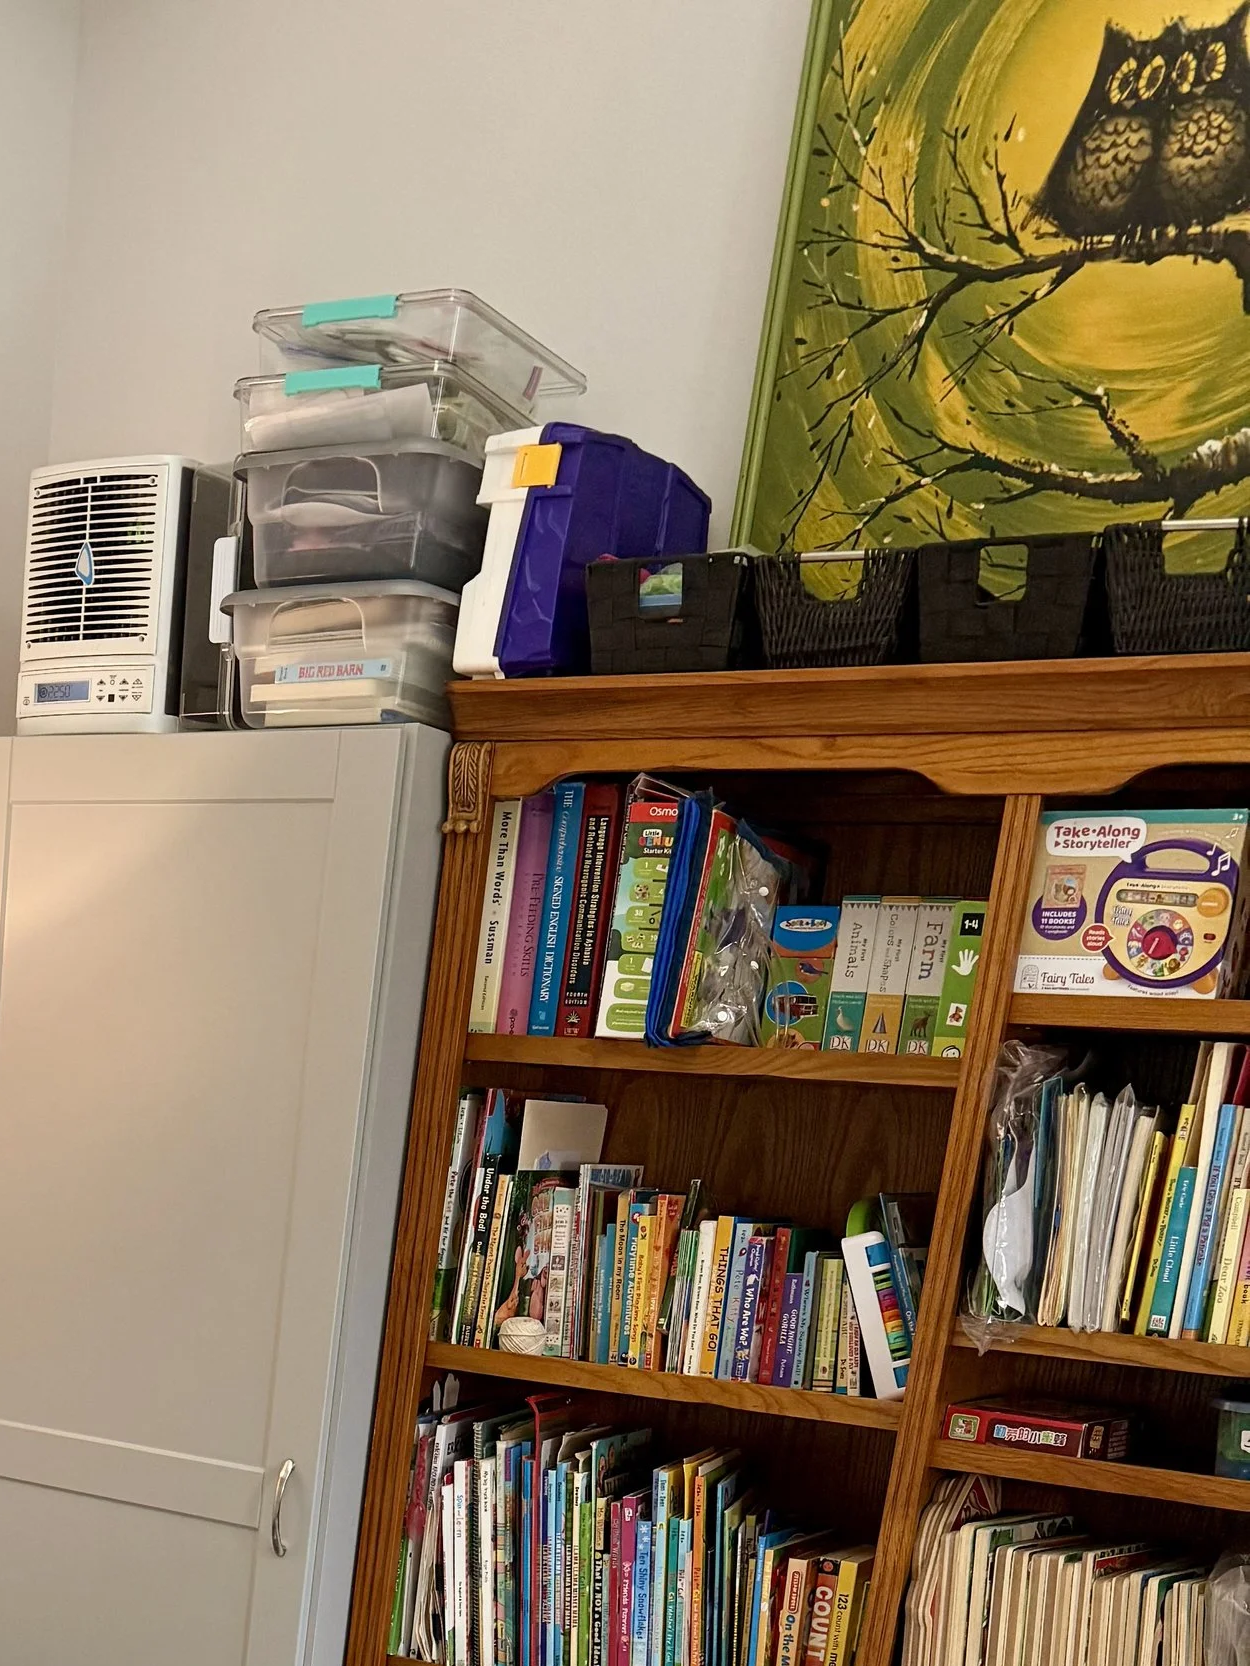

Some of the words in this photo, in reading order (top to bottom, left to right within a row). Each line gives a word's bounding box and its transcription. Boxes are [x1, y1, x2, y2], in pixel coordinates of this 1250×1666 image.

[298, 666, 315, 679] BIG
[316, 665, 335, 678] RED
[336, 663, 364, 677] BARN
[563, 790, 574, 808] THE
[650, 806, 679, 817] Osmo
[501, 811, 513, 839] More
[587, 817, 596, 831] and
[596, 817, 609, 851] Language
[584, 832, 595, 858] Related
[1061, 839, 1133, 850] Storyteller
[497, 844, 509, 868] Than
[579, 859, 592, 898] Neurogenic
[592, 852, 605, 893] Intervention
[551, 876, 564, 909] SIGNED
[586, 894, 600, 930] Strategies
[1041, 917, 1049, 925] 11
[546, 911, 560, 948] ENGLISH
[573, 899, 587, 951] Communication
[886, 913, 899, 947] Colors
[963, 919, 979, 930] 1-4
[484, 920, 499, 965] Sussman
[583, 938, 594, 966] Aphasia
[844, 922, 863, 979] Animals
[918, 921, 944, 980] Farm
[520, 945, 535, 977] SKILLS
[568, 952, 581, 985] Disorders
[539, 951, 555, 1002] DICTIONARY
[879, 957, 893, 993] Shapes
[1040, 972, 1067, 987] Fairy
[1068, 972, 1095, 984] Tales
[831, 1036, 850, 1049] DK
[868, 1039, 887, 1052] DK
[908, 1039, 927, 1053] DK
[483, 1167, 495, 1194] Under
[481, 1196, 490, 1210] the
[1230, 1196, 1241, 1231] Campbell
[477, 1211, 488, 1232] Bed!
[475, 1241, 483, 1255] David
[618, 1234, 626, 1253] Moon
[1167, 1236, 1180, 1258] Little
[1197, 1234, 1209, 1267] Pancake
[615, 1265, 623, 1277] my
[637, 1255, 645, 1275] Baby's
[714, 1247, 730, 1294] THINGS
[1162, 1259, 1176, 1283] Cloud
[1222, 1257, 1233, 1282] Dear
[614, 1279, 622, 1300] Room
[733, 1269, 744, 1290] Pete
[744, 1287, 754, 1308] Who
[1216, 1283, 1226, 1304] Zoo
[1241, 1284, 1250, 1305] book
[623, 1280, 635, 1336] Adventures
[633, 1292, 641, 1319] Playtime
[711, 1298, 722, 1329] THAT
[741, 1309, 751, 1329] Are
[779, 1313, 789, 1345] GORILLA
[790, 1309, 798, 1329] GOOD
[707, 1333, 718, 1352] GO!
[739, 1328, 749, 1346] We?
[594, 1558, 602, 1581] That
[639, 1551, 649, 1566] Ten
[637, 1567, 648, 1591] Shiny
[594, 1593, 602, 1612] NOT
[837, 1593, 849, 1611] 123
[636, 1593, 647, 1640] Snowflakes
[785, 1614, 796, 1631] On
[808, 1586, 834, 1662] COUNT
[834, 1611, 843, 1632] count
[593, 1621, 601, 1643] Good
[783, 1633, 794, 1653] the
[831, 1632, 840, 1651] with
